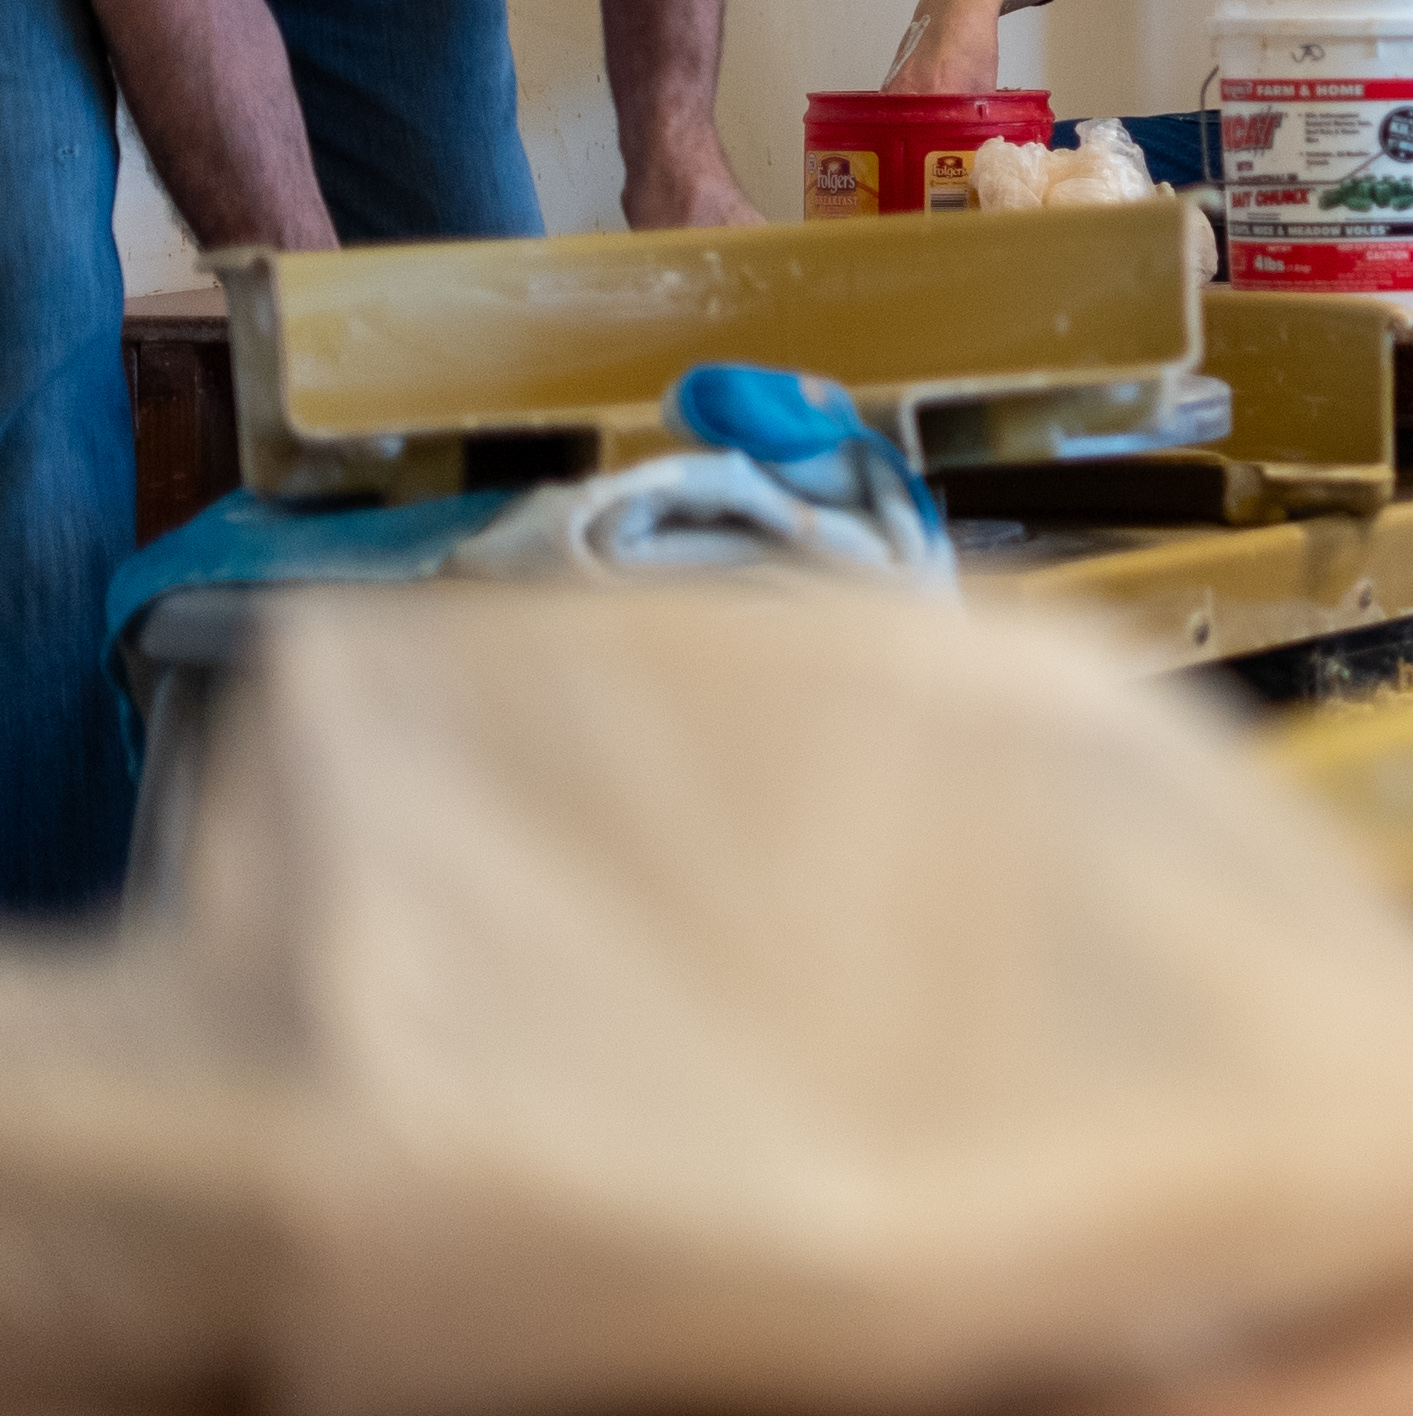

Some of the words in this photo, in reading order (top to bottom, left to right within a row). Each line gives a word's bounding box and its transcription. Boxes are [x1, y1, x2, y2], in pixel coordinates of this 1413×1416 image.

[1256, 85, 1295, 97] FARM
[1301, 85, 1310, 97] &
[1316, 85, 1364, 97] HOME
[933, 164, 966, 179] Folgers
[817, 166, 856, 194] Folgers
[815, 195, 858, 205] BREAKFAST
[1287, 226, 1341, 236] MEADOW
